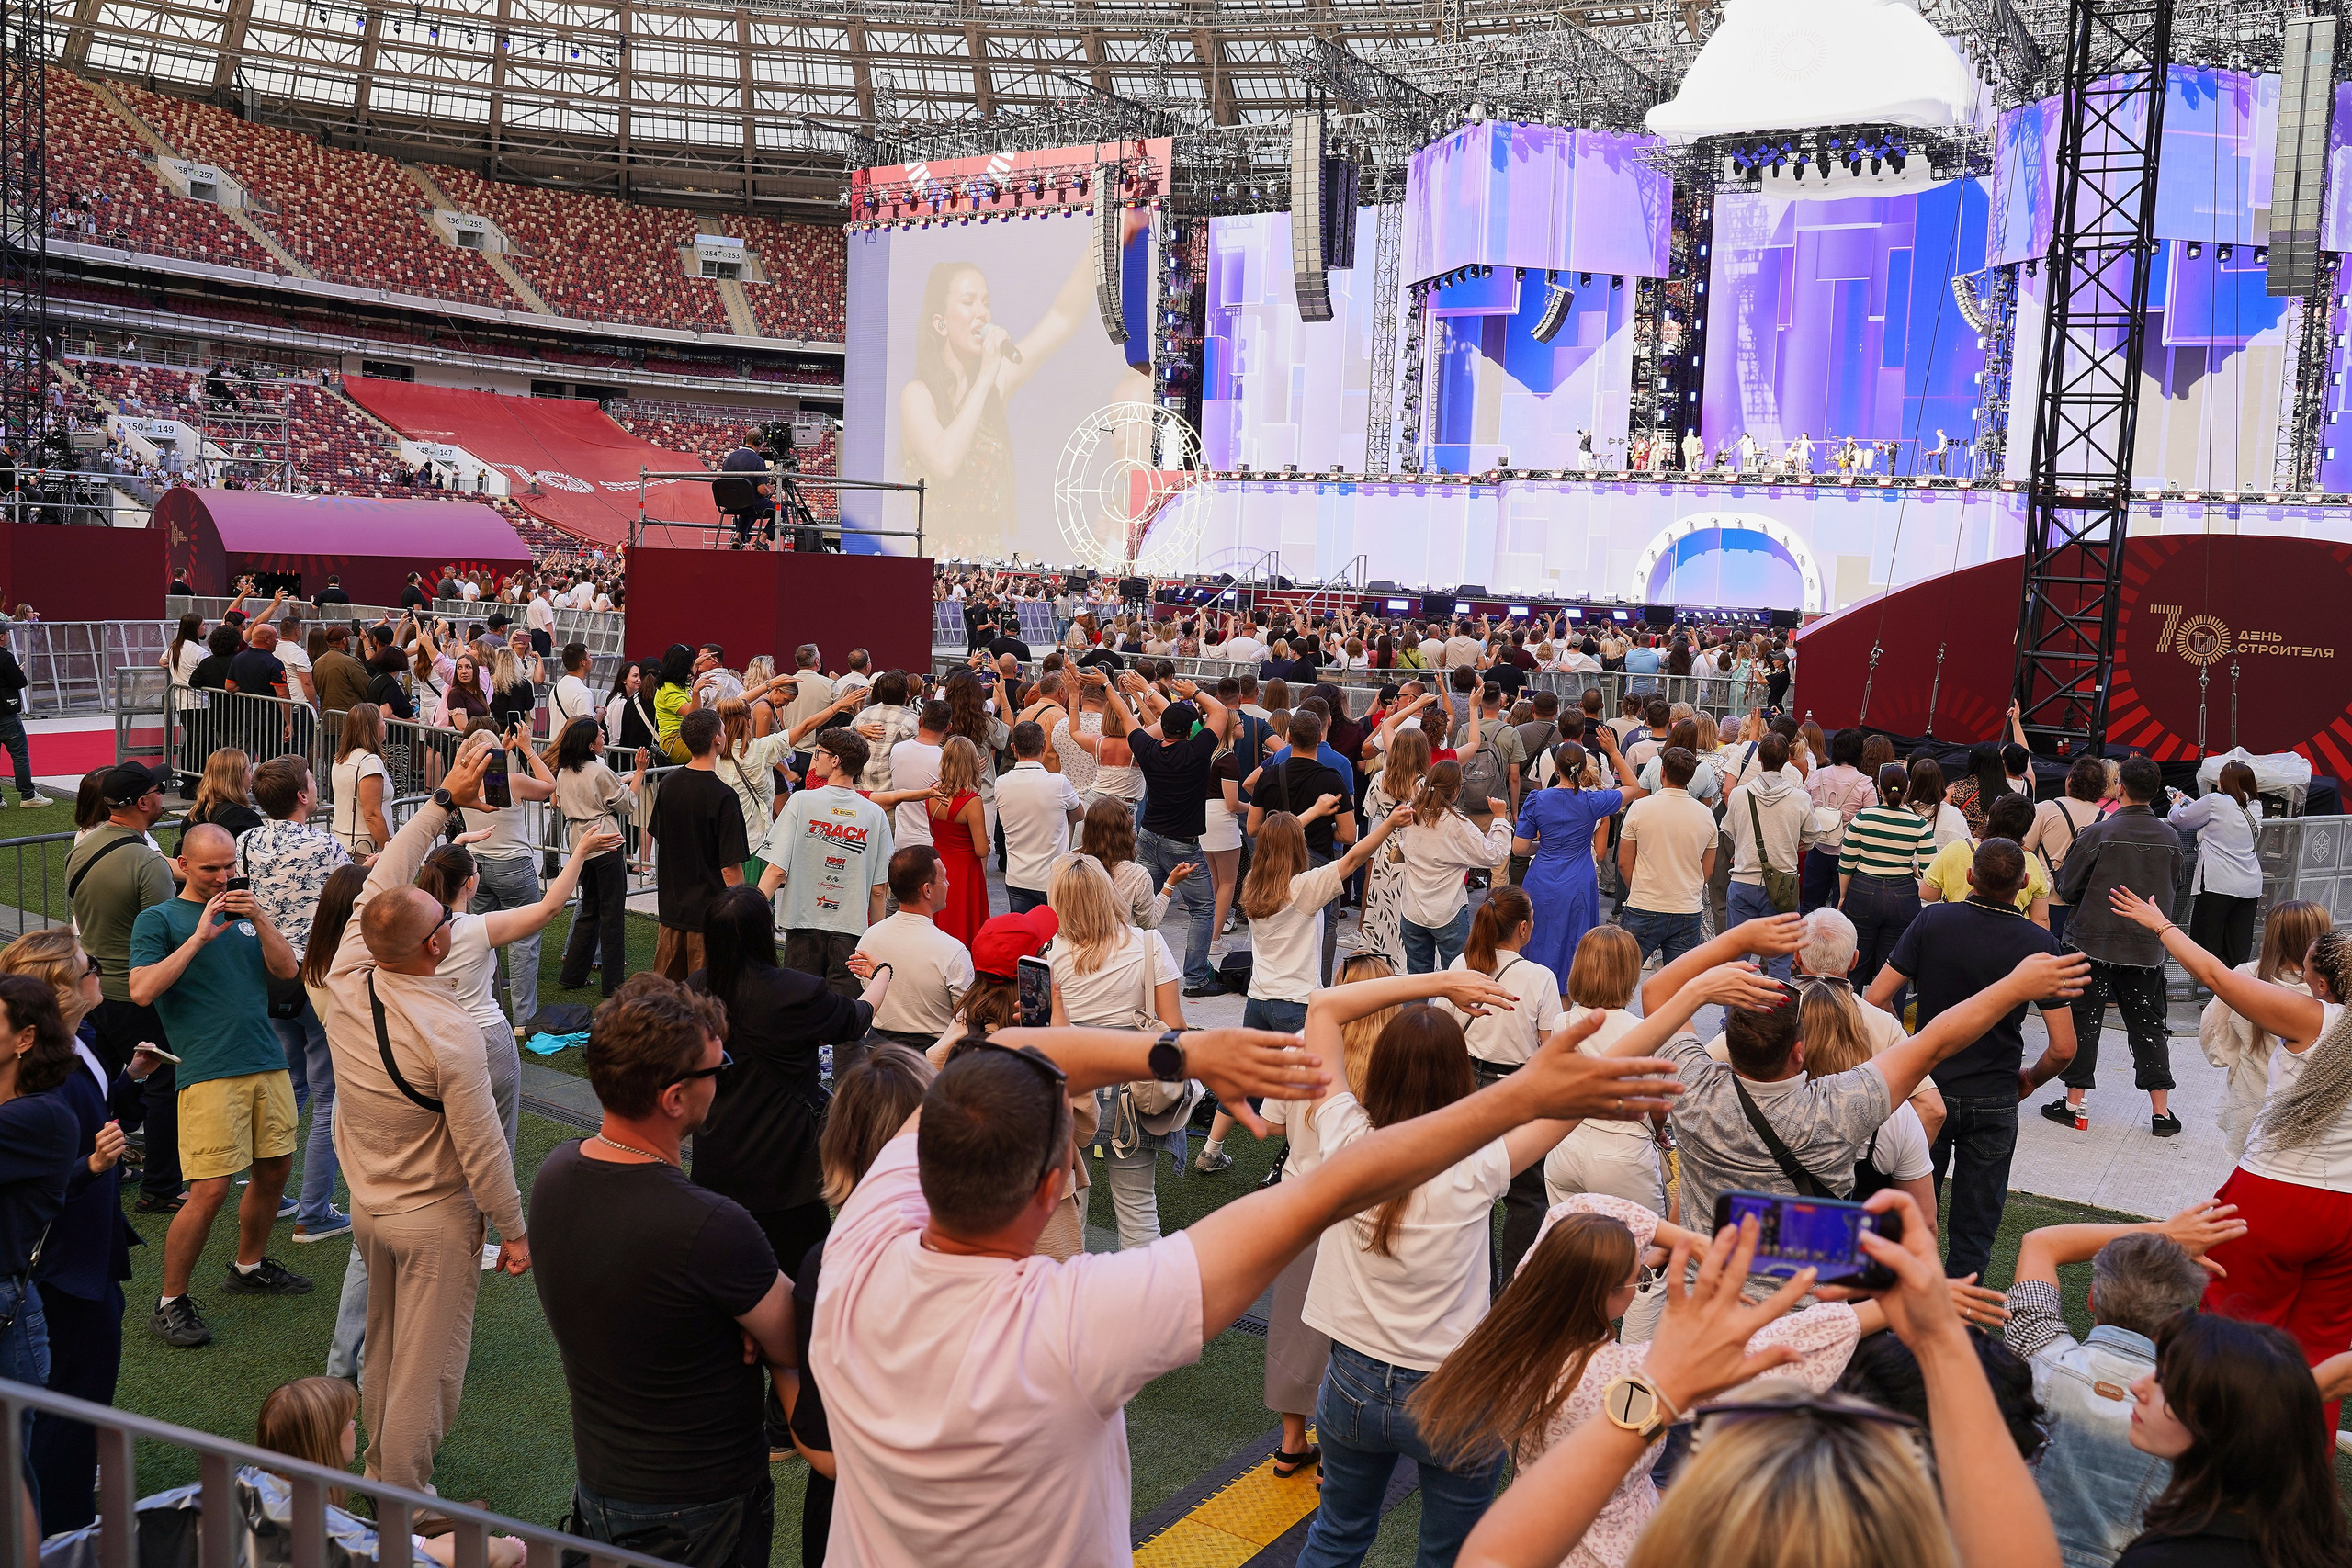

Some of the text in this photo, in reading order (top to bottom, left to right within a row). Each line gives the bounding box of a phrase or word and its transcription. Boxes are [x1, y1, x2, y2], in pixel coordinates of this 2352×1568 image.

[199, 171, 214, 179] 257
[447, 217, 460, 225] 256
[469, 220, 483, 229] 255
[158, 424, 175, 434] 149
[416, 446, 429, 455] 48
[440, 448, 453, 457] 147
[2237, 630, 2283, 642] ДЕНЬ
[2236, 642, 2335, 659] СТРОИТЕЛЯ
[808, 819, 869, 842] TRACK
[826, 856, 846, 865] 1991
